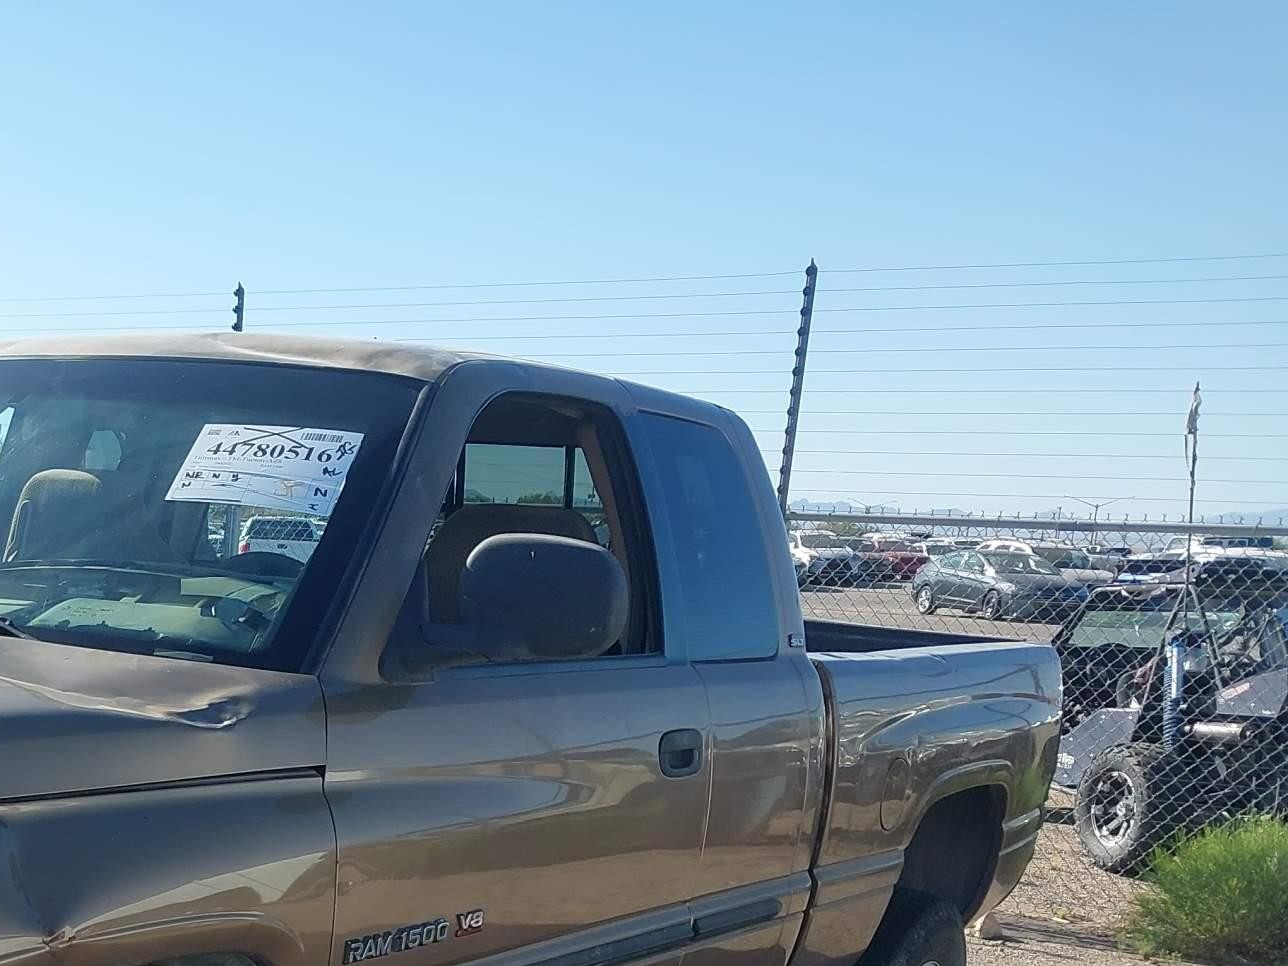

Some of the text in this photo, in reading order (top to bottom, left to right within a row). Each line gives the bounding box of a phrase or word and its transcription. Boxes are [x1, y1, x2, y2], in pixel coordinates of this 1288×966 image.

[206, 441, 335, 463] 44780516
[345, 910, 484, 963] RAM 1500 V8
